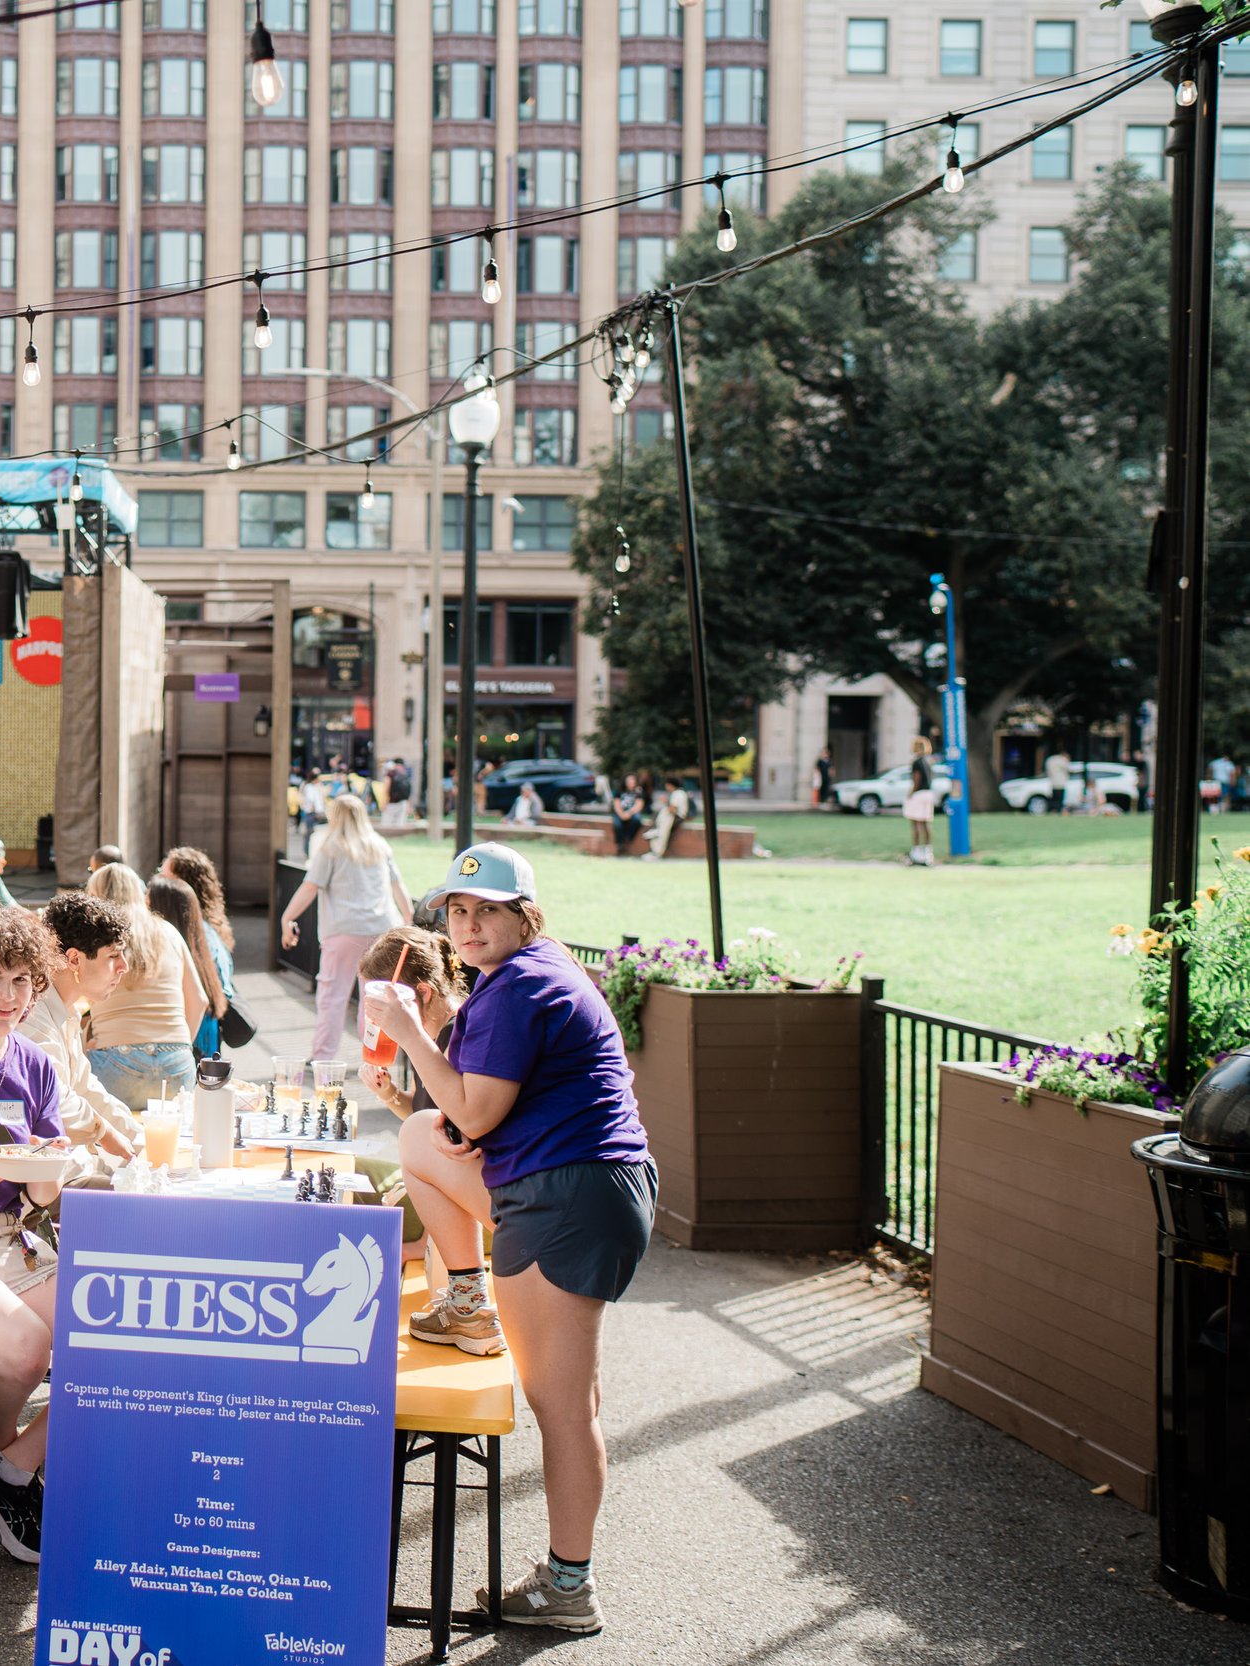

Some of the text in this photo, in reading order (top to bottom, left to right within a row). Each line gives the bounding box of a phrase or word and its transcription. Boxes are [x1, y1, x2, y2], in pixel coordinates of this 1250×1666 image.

[71, 1272, 298, 1339] CHESS
[64, 1382, 380, 1415] Capture the opponent's King (just like in regular Chess),
[77, 1397, 365, 1426] but with two new pieces: the Jester and the Paladin.
[191, 1451, 244, 1466] Players:
[213, 1469, 220, 1480] 2
[196, 1497, 235, 1511] Time:
[174, 1513, 255, 1530] Up to 60 mins
[166, 1542, 261, 1558] Game Designers:
[94, 1559, 332, 1591] Ailey Adair, Michael Chow, Qian Luo,
[130, 1577, 294, 1600] Wanxuan Yan, Zoe Golden
[51, 1619, 142, 1634] ALL ARE WELCOME!
[49, 1628, 141, 1666] DAY
[283, 1654, 325, 1665] STUDIOS
